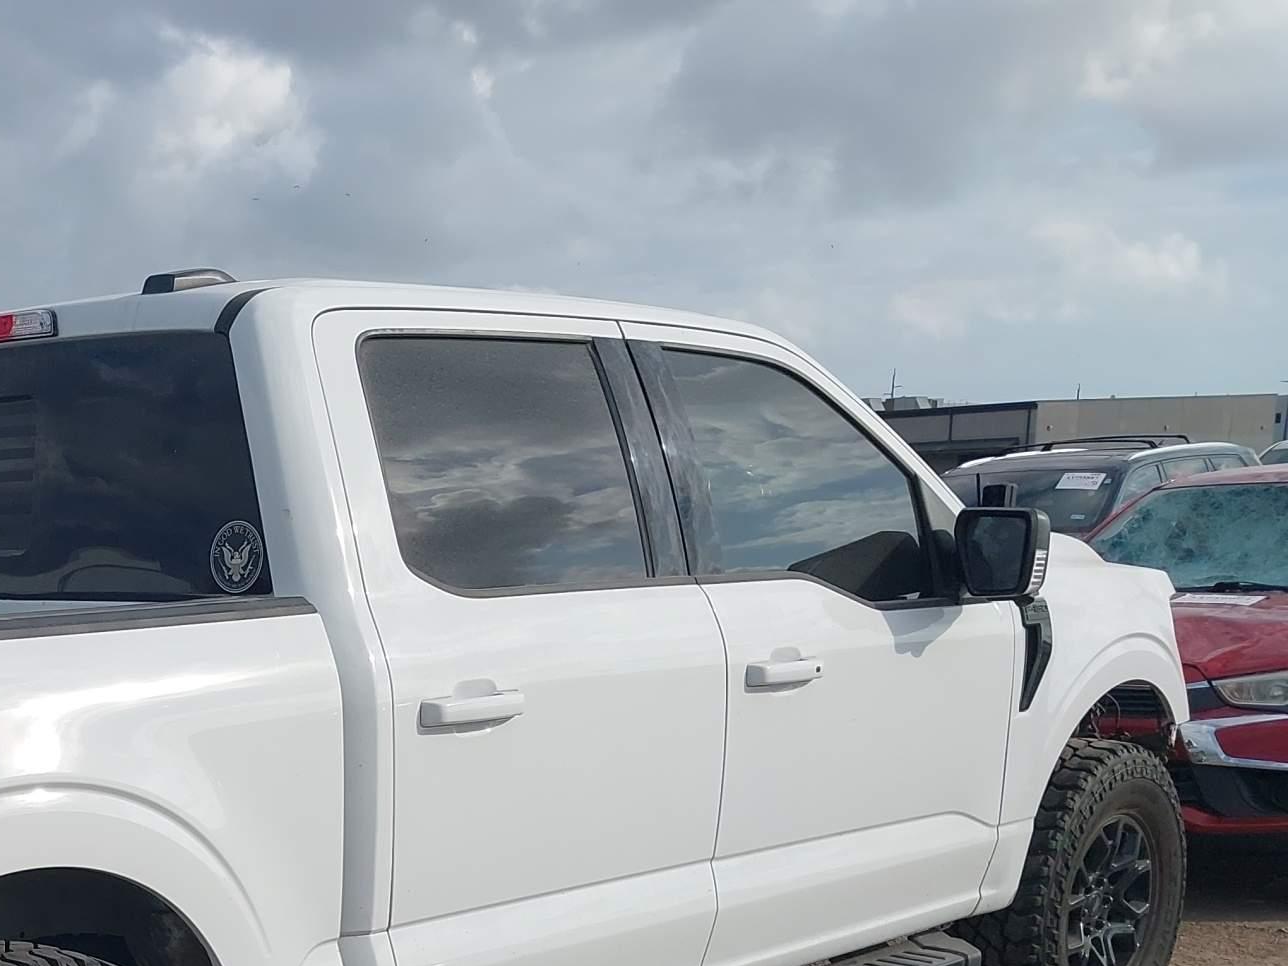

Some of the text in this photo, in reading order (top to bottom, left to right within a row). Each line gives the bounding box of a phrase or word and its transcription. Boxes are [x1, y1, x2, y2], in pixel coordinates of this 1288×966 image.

[213, 526, 260, 557] IN GOD WE TRUST
